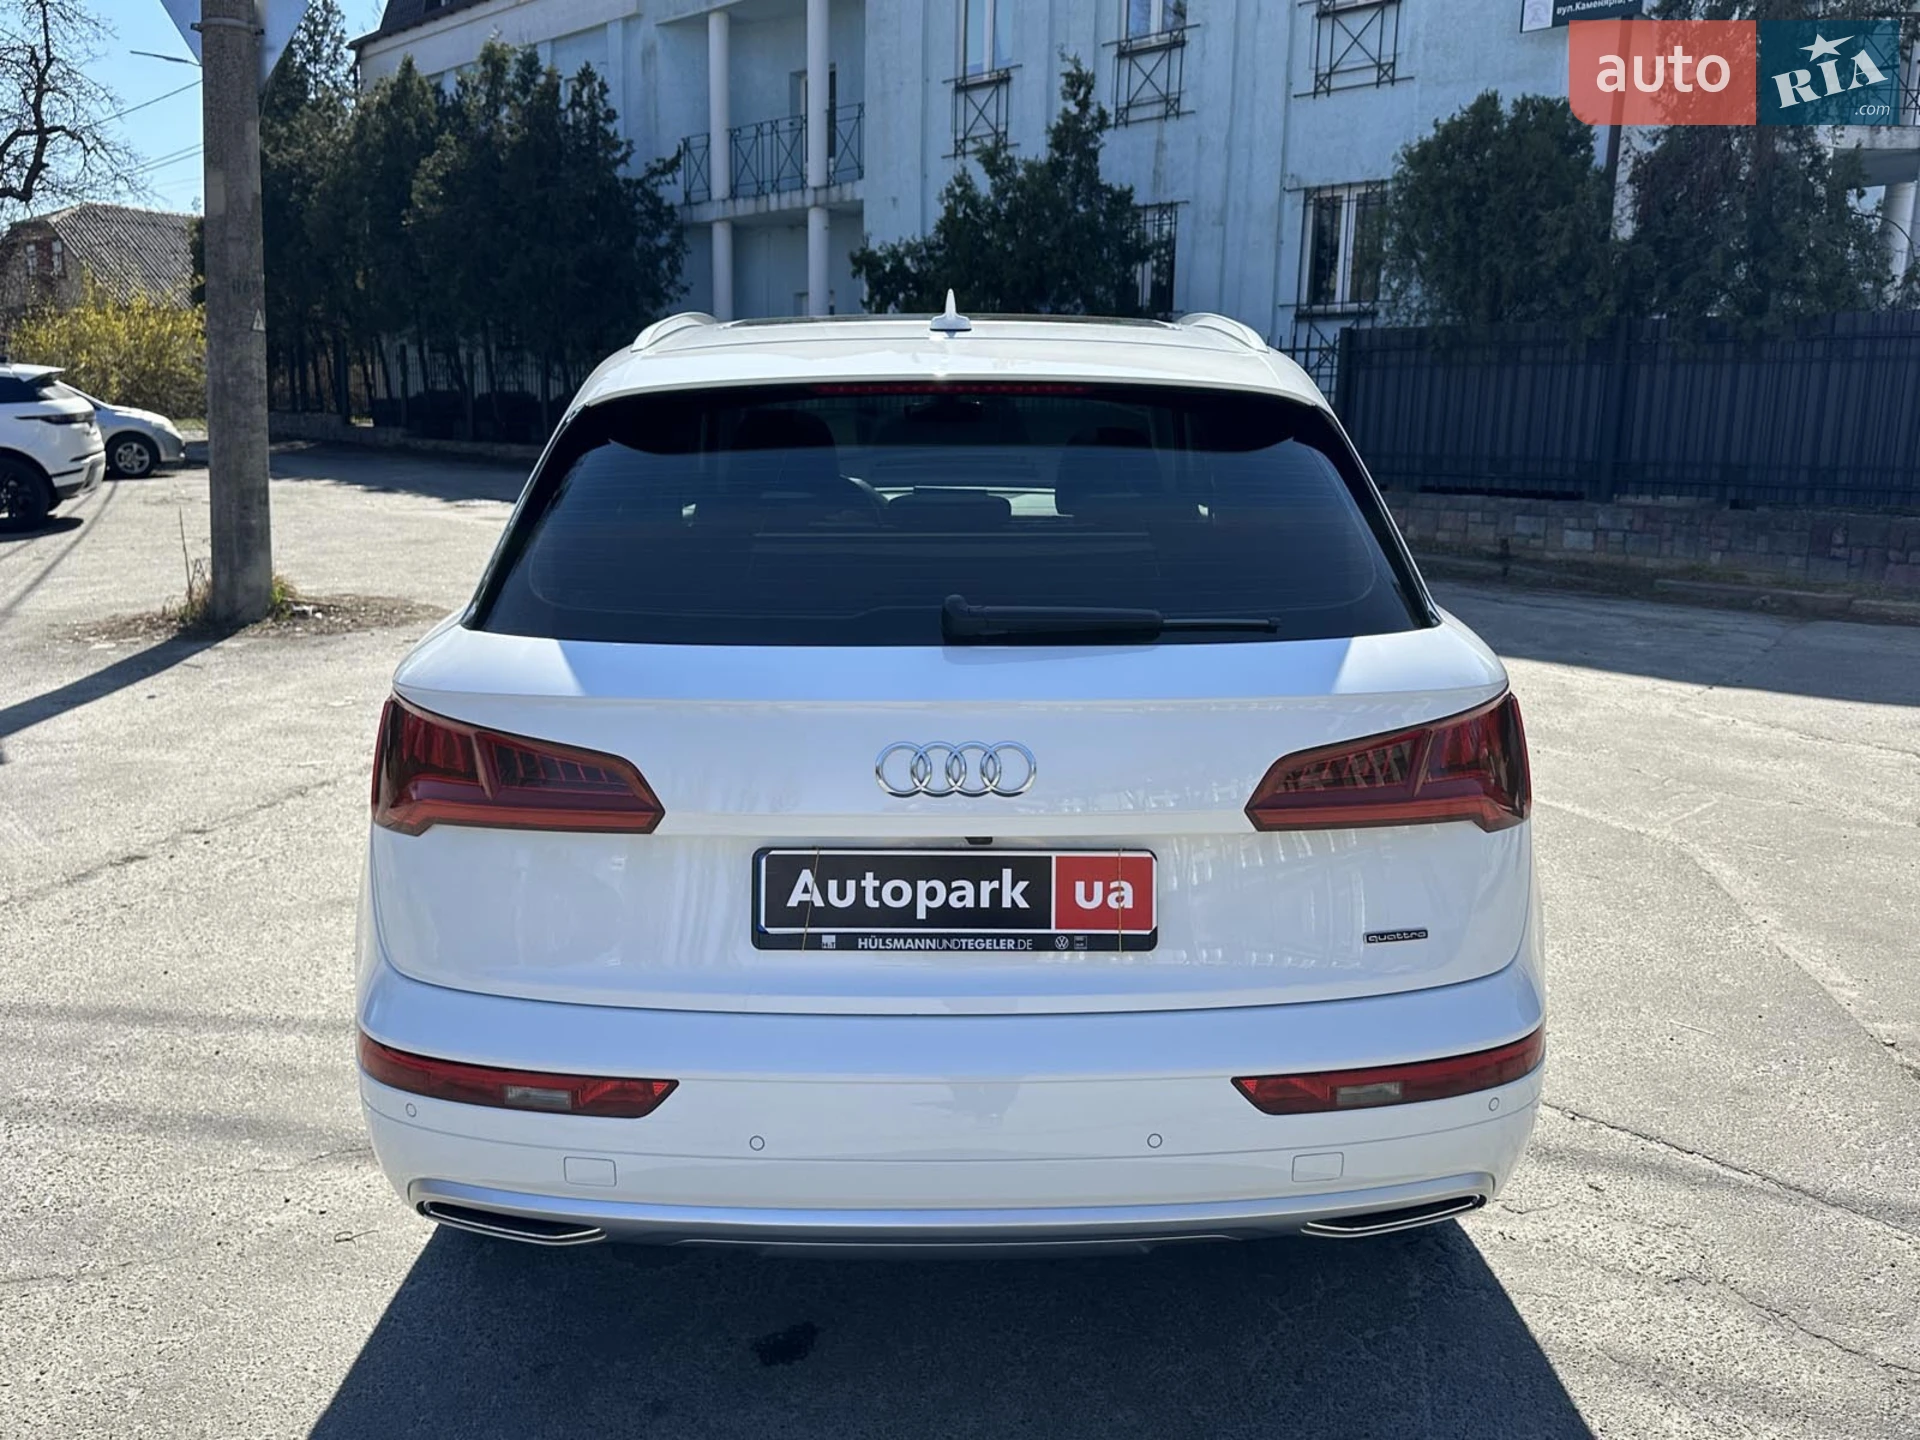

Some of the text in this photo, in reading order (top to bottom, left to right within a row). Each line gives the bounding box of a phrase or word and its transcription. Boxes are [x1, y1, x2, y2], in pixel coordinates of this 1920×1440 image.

[787, 868, 1134, 919] Autopark ua
[858, 935, 1033, 950] HÜLSMANNUNDTEGELER.DE
[1368, 931, 1426, 943] quattro
